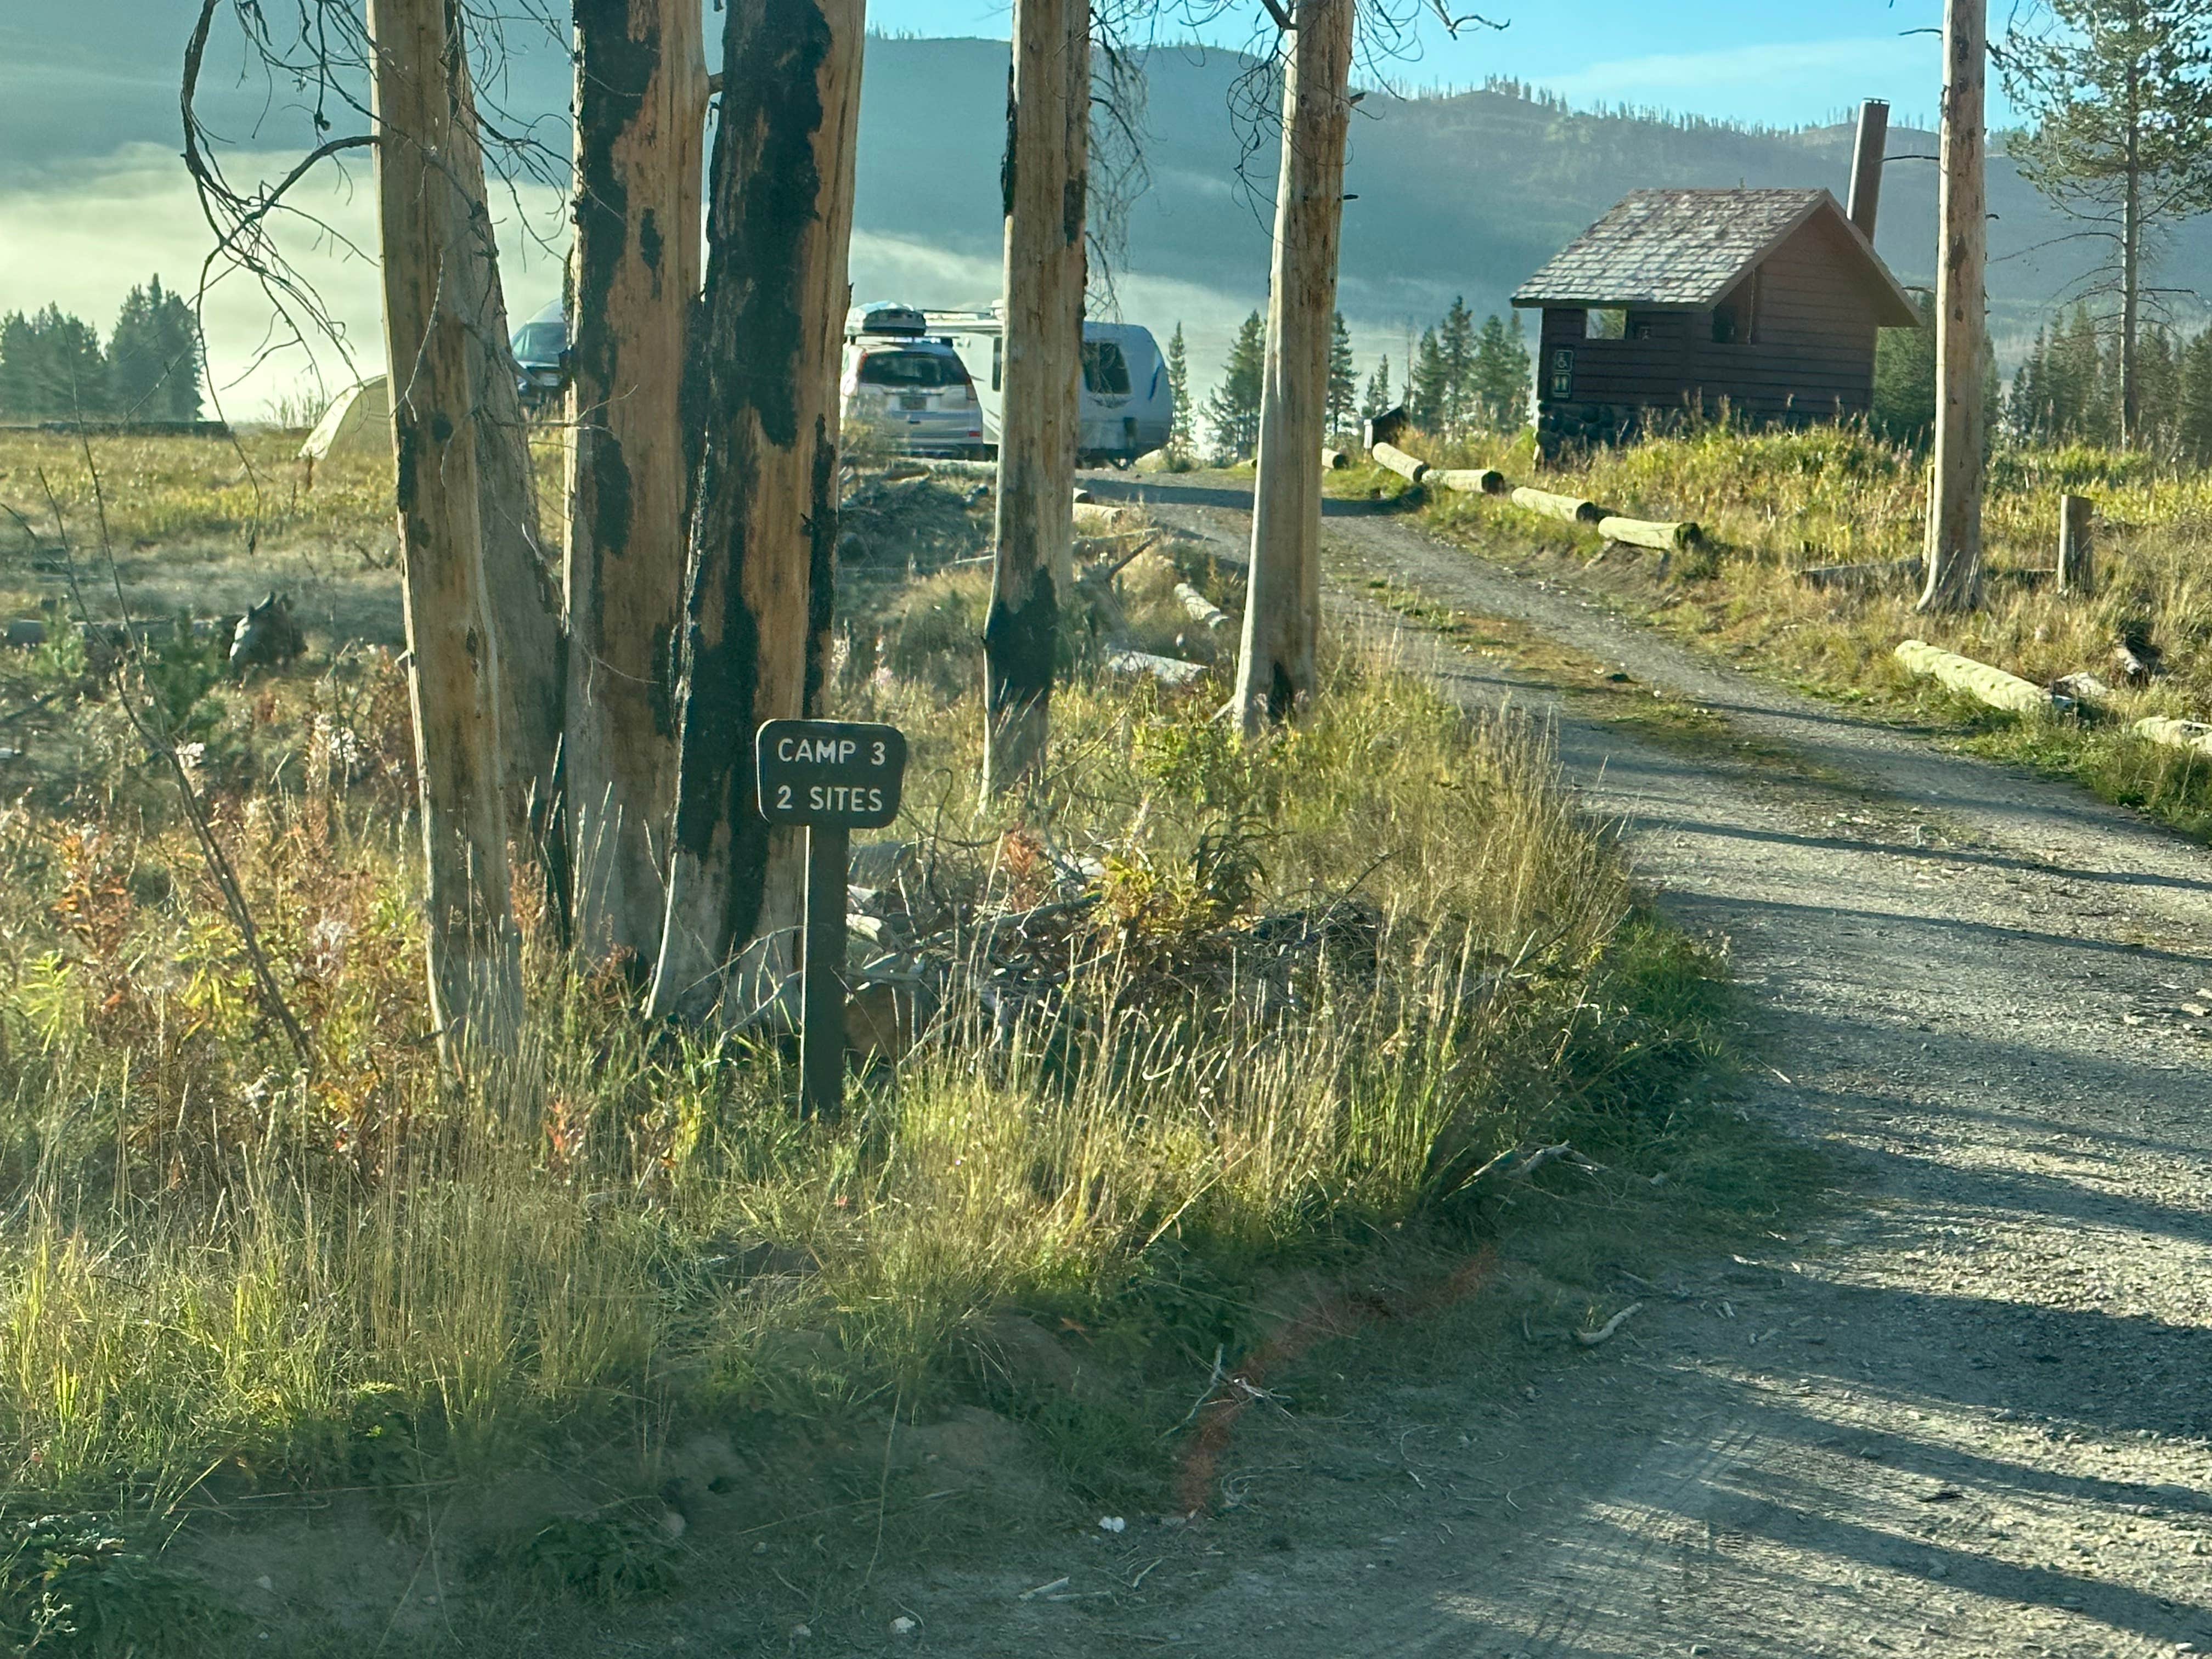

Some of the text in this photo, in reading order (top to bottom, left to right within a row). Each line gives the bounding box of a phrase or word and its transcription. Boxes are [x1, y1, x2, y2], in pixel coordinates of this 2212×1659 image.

[778, 738, 885, 766] CAMP 3
[776, 785, 882, 812] 2 SITES
